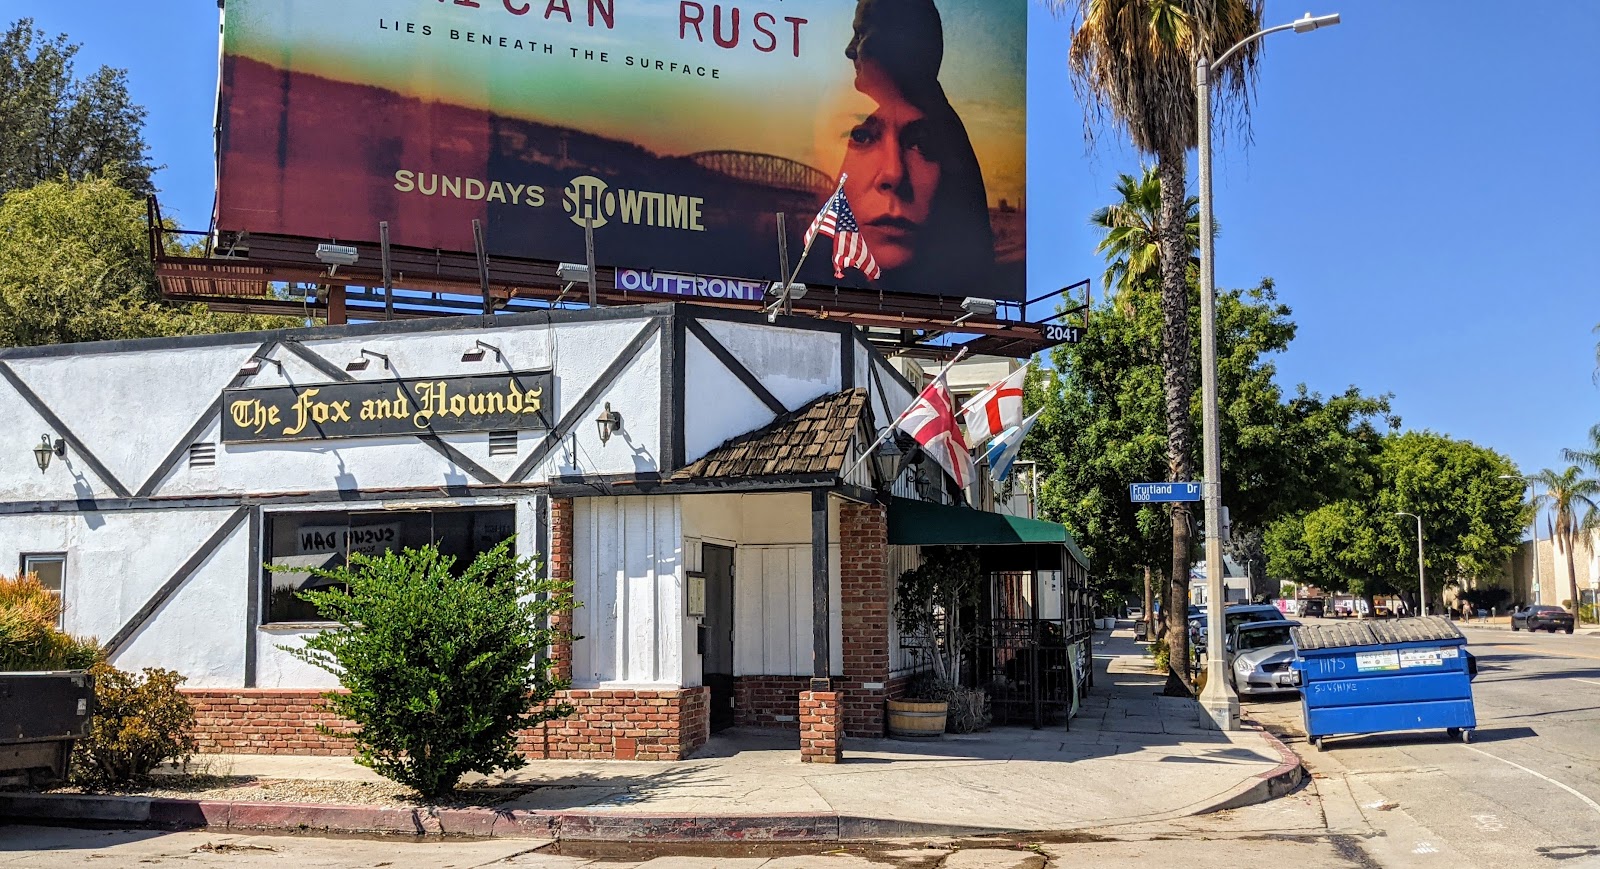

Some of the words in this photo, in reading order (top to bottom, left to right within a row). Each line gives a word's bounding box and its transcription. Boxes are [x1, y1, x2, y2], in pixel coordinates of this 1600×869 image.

[379, 18, 432, 36] LIES
[450, 29, 553, 54] BENEATH
[570, 47, 609, 63] THE
[625, 56, 720, 79] SURFACE
[679, 0, 808, 58] RUST
[394, 169, 545, 207] SUNDAYS
[562, 175, 705, 231] SHOWTIME
[621, 269, 761, 300] OUTFRONT
[1046, 325, 1078, 342] 2041
[230, 398, 280, 434] The
[282, 388, 350, 435] Fox
[360, 383, 410, 421] and
[413, 378, 543, 429] Hounds
[1132, 484, 1172, 494] Fruitland
[1187, 484, 1198, 494] Dr
